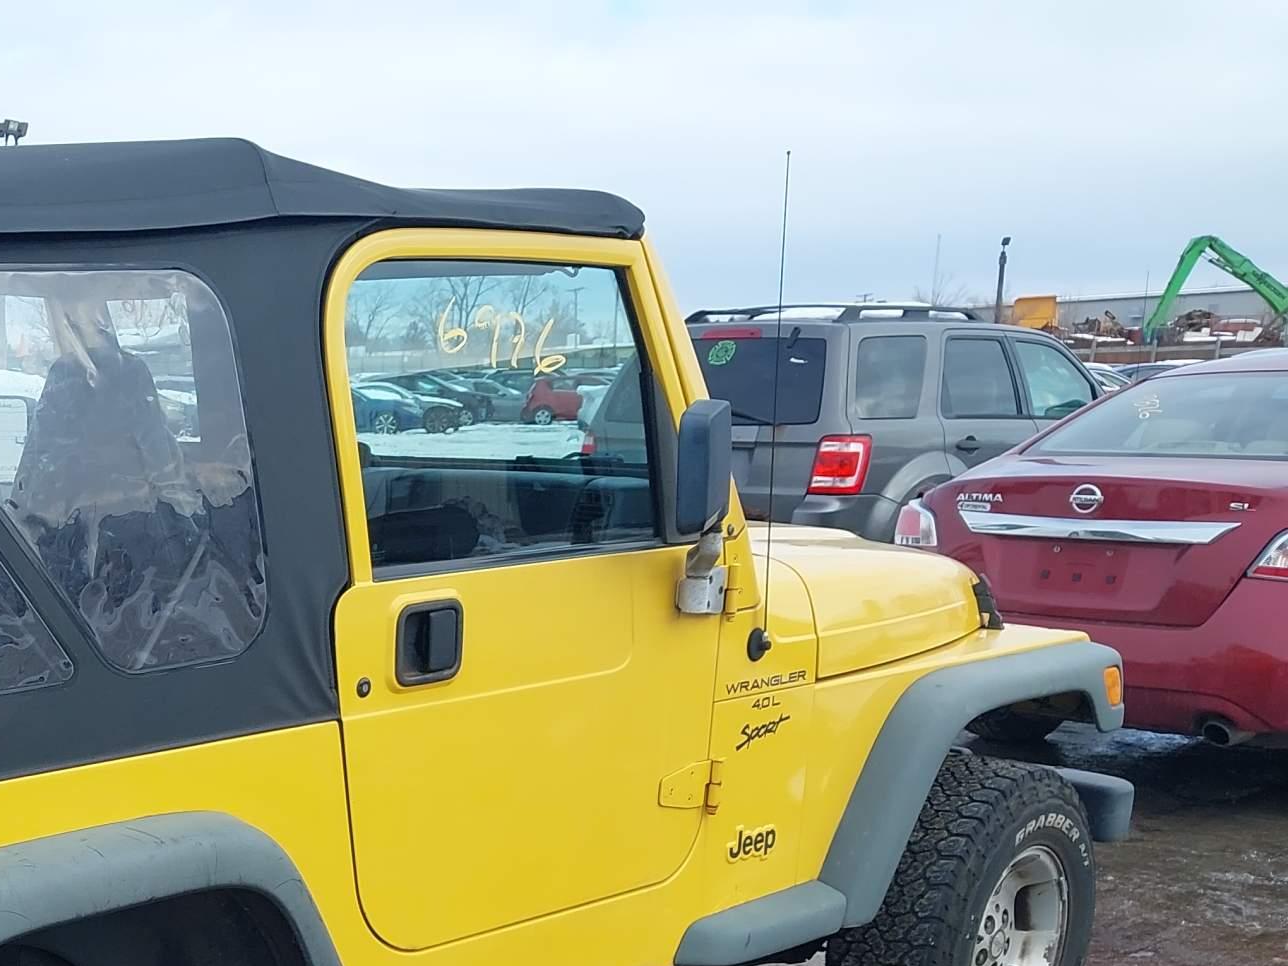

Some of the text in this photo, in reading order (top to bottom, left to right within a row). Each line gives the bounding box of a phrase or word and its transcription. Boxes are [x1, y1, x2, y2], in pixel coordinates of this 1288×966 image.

[438, 296, 567, 376] 6976
[956, 493, 1004, 502] ALTIMA
[1229, 502, 1257, 512] SL
[726, 670, 807, 695] WRANGLER
[735, 713, 791, 752] Sport
[728, 828, 777, 860] Jeep
[1015, 812, 1081, 848] GRABBER
